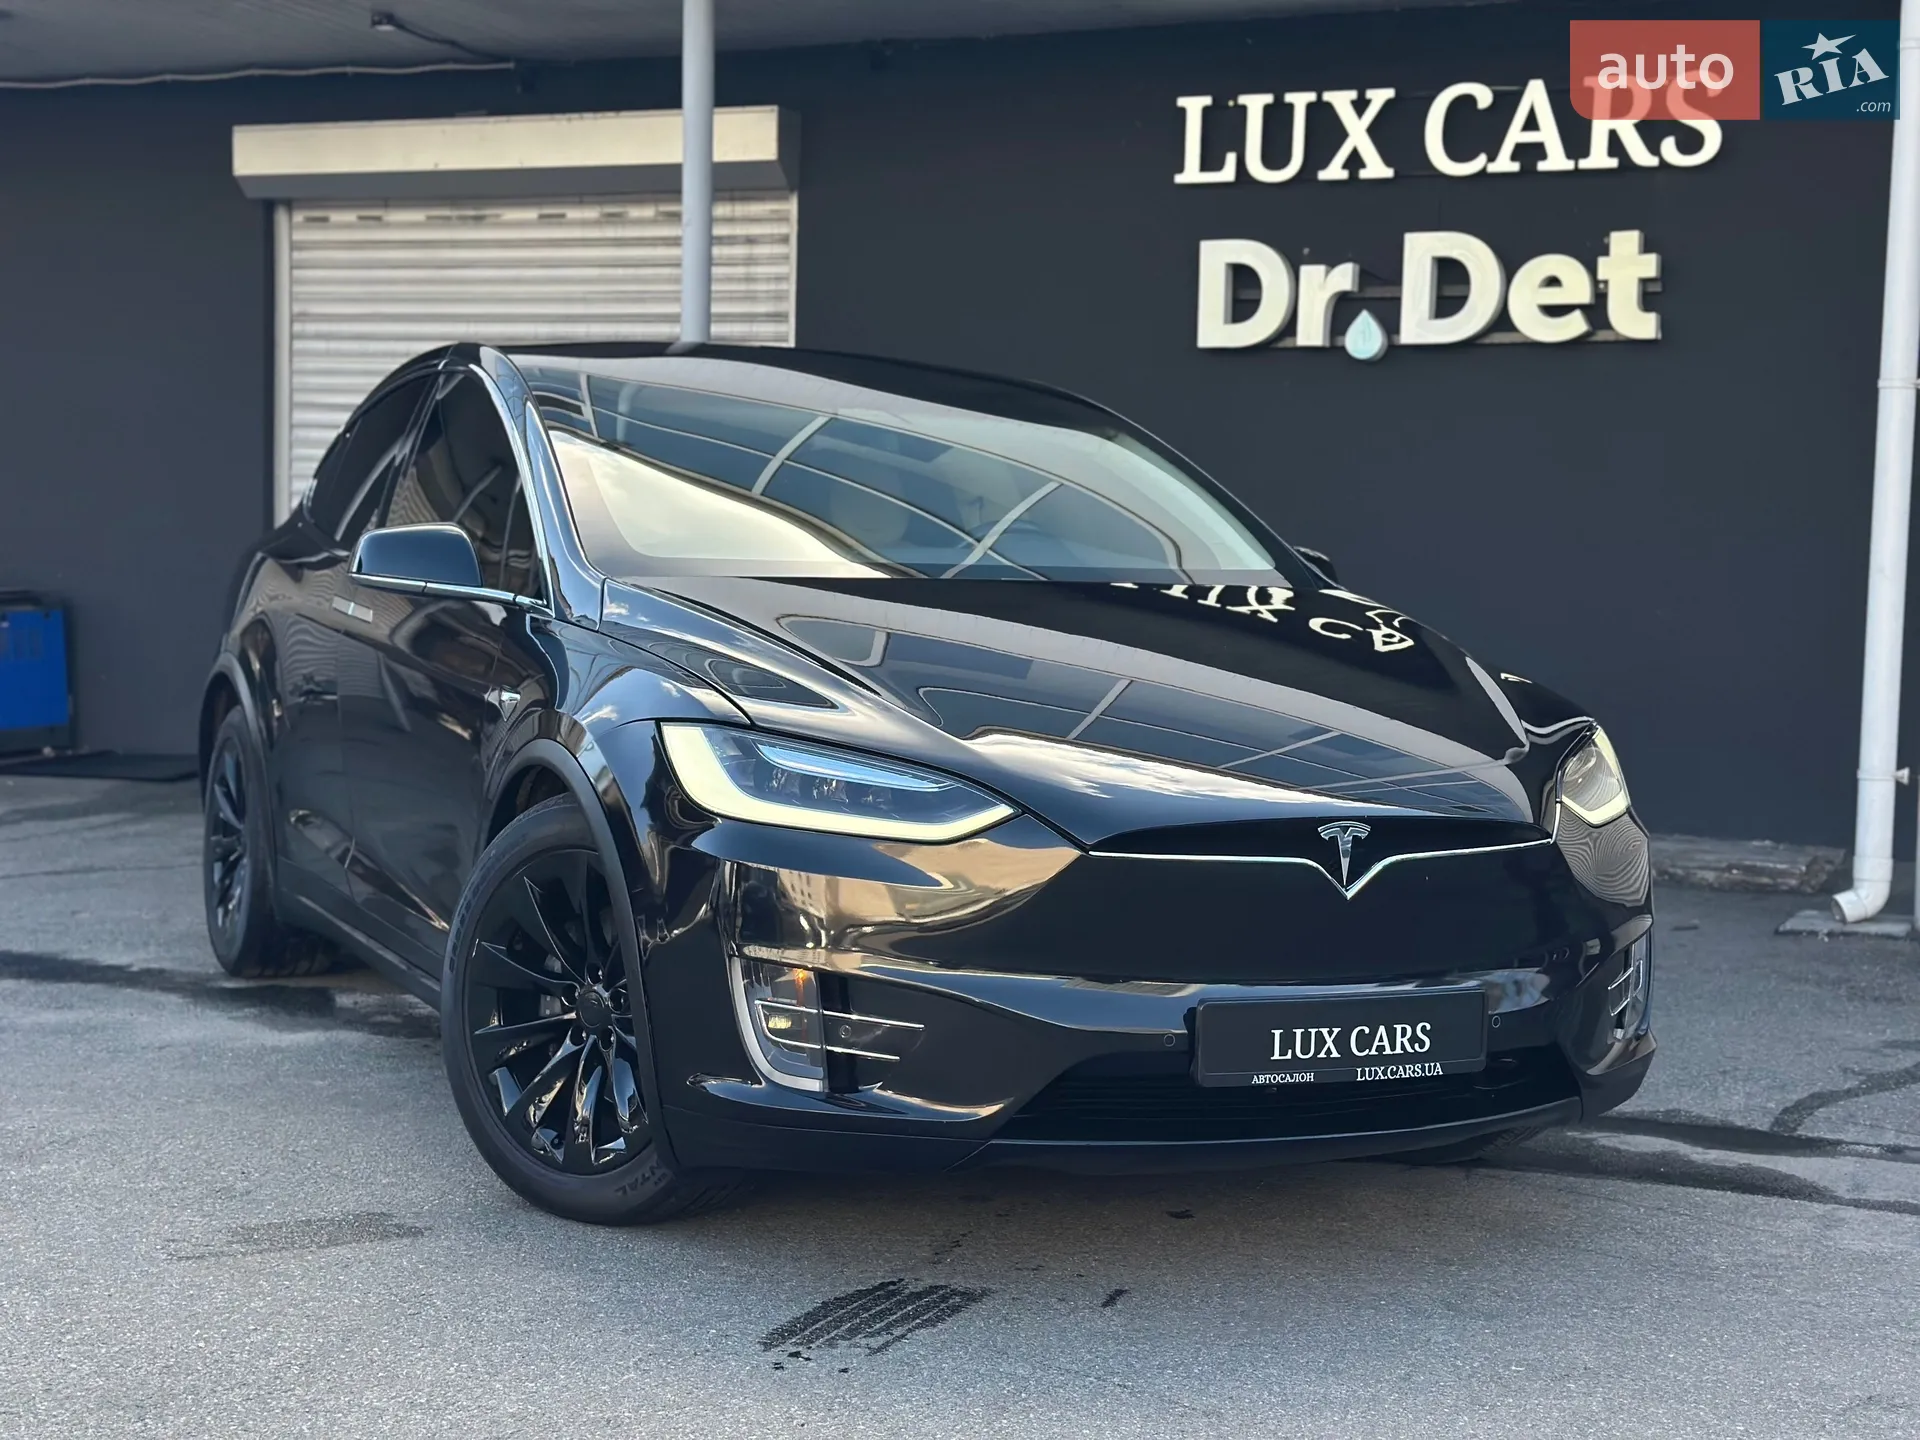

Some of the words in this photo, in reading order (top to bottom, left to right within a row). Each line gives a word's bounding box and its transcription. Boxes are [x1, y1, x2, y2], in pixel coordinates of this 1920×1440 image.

[1174, 87, 1396, 184] LUX
[1423, 70, 1724, 176] CARS
[1270, 1027, 1341, 1060] LUX
[1350, 1022, 1431, 1056] CARS
[1251, 1072, 1315, 1084] АВТОСАЛОН
[1356, 1062, 1443, 1081] LUX.CARS.UA
